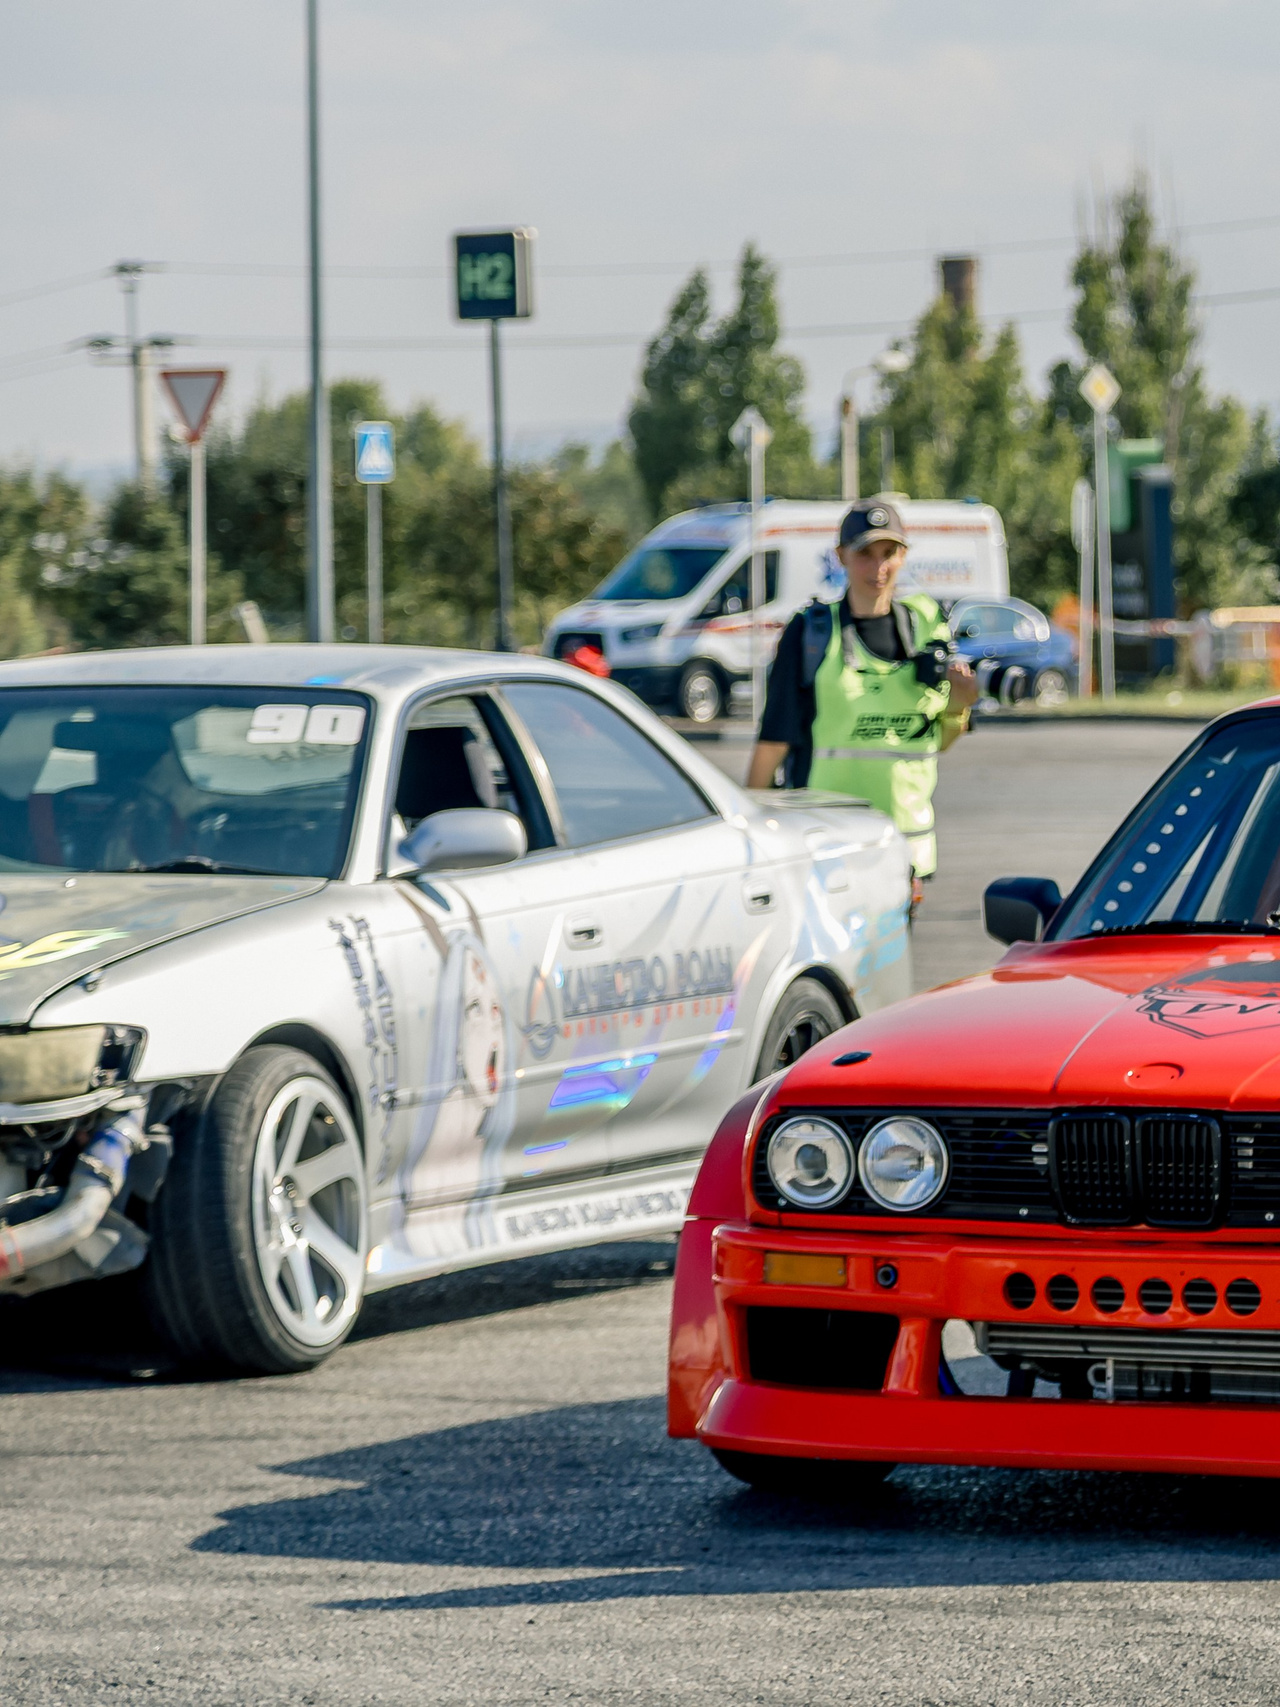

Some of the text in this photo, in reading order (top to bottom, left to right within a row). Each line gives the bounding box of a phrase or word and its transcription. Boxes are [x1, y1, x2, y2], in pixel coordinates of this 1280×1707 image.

[459, 252, 513, 300] H2
[246, 704, 366, 745] 90
[563, 948, 734, 1017] КАЧЕСТВО ВОДЫ
